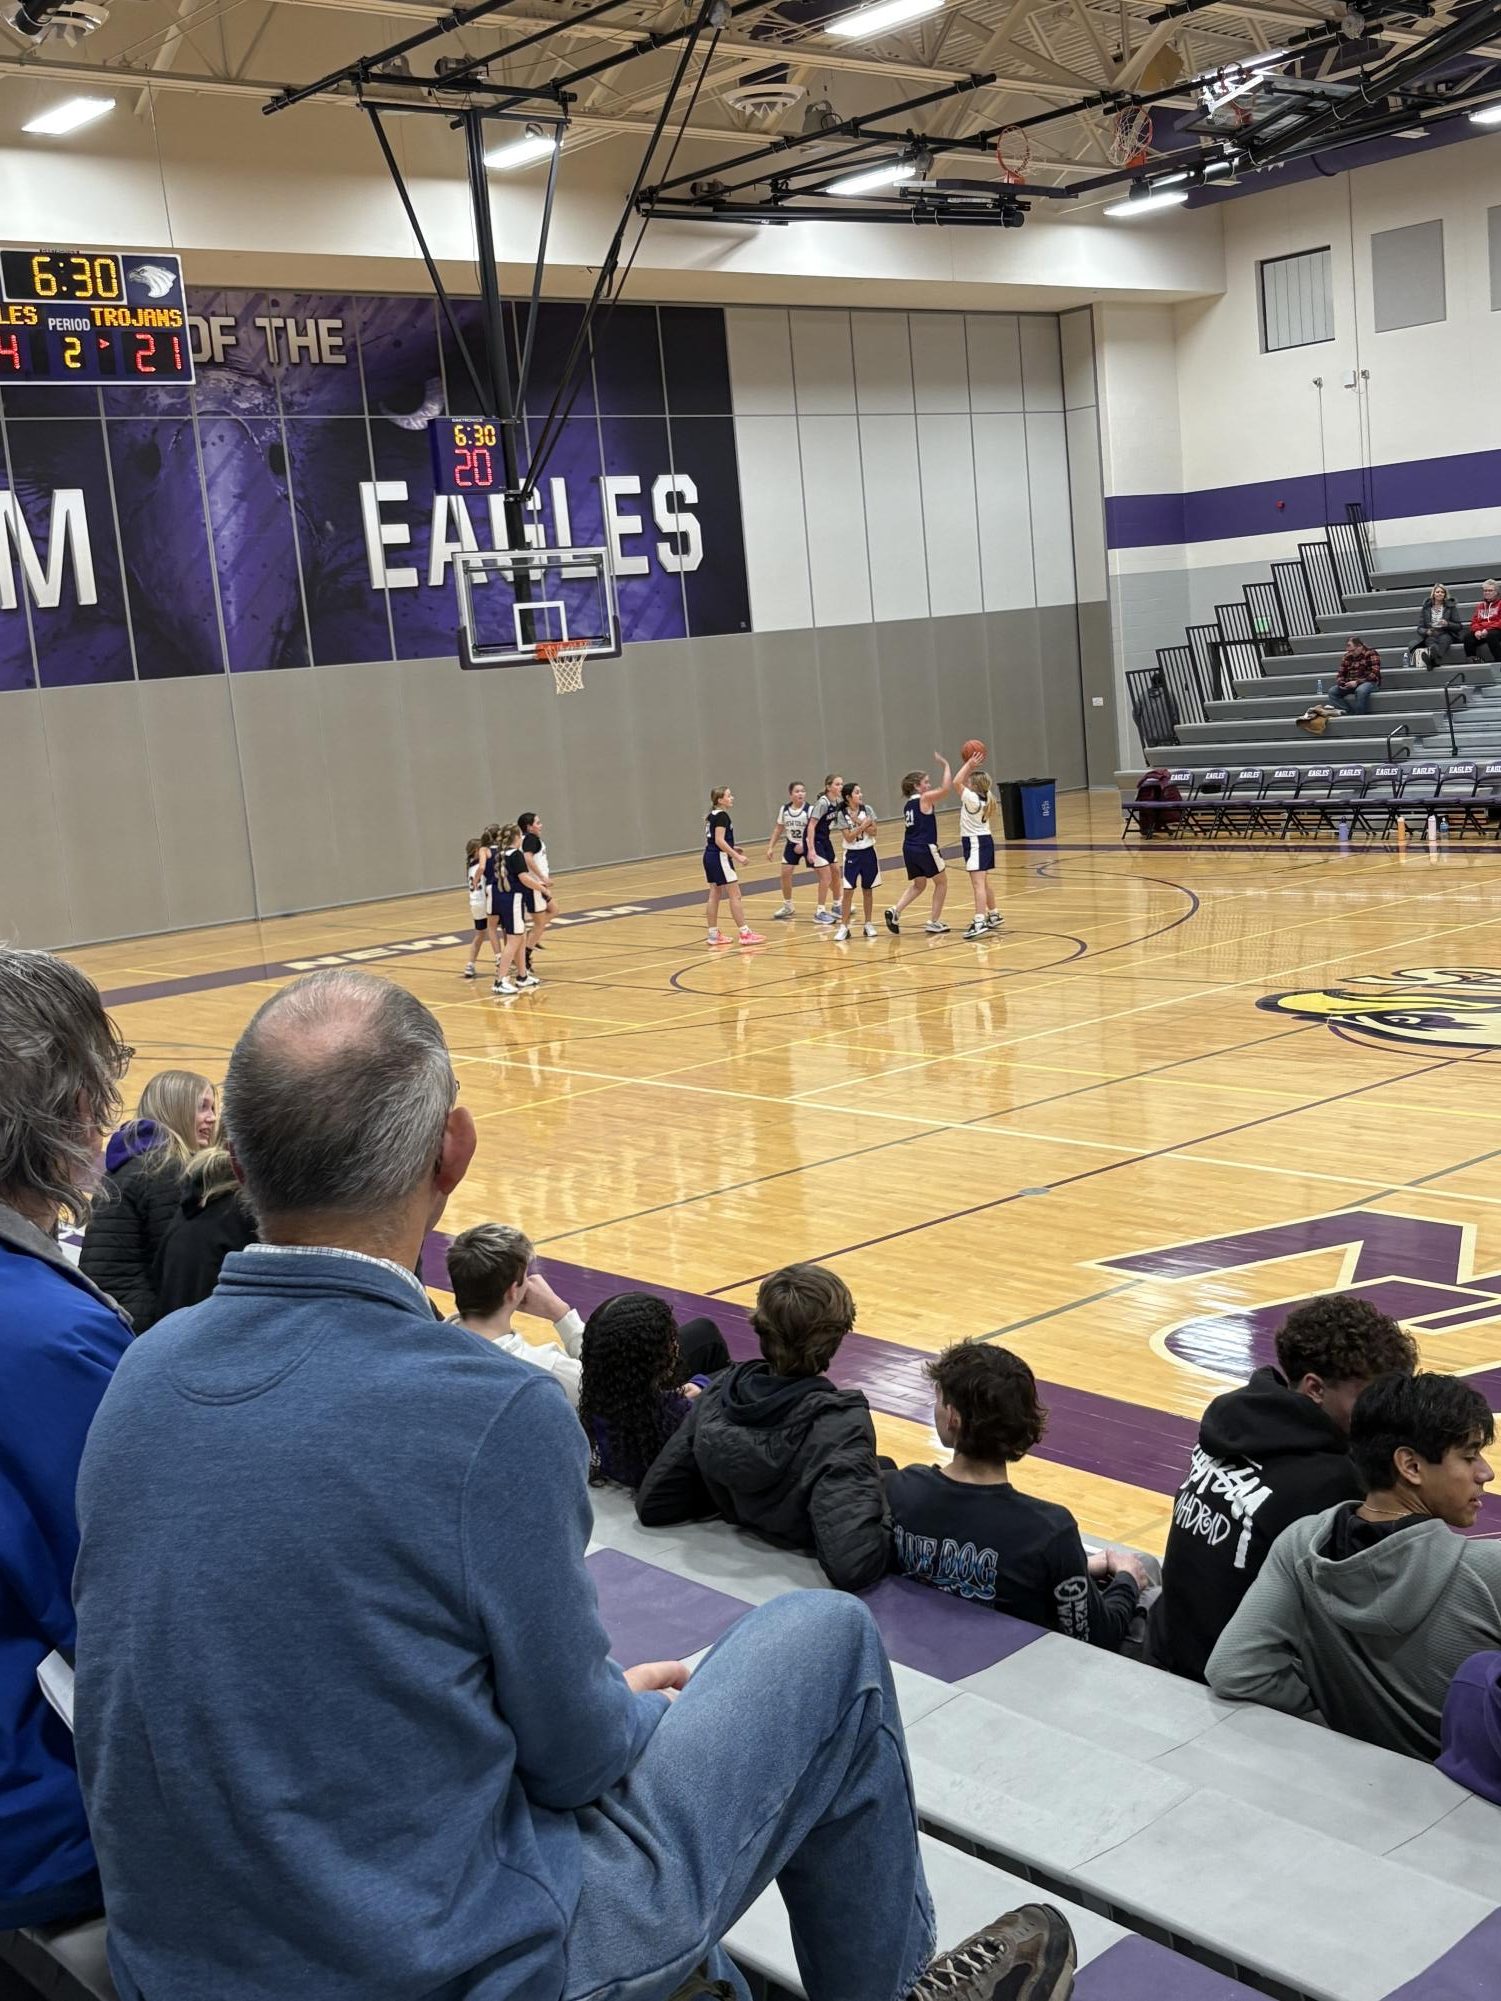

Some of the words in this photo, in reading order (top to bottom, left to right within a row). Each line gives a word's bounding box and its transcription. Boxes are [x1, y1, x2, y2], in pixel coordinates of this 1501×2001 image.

[31, 256, 117, 298] 6:30
[48, 317, 91, 331] PERIOD
[90, 307, 184, 328] TROJANS
[190, 315, 239, 363] OF
[255, 315, 347, 365] THE
[64, 337, 82, 368] 2
[135, 332, 182, 372] 21
[454, 424, 497, 446] 6:30
[454, 449, 493, 487] 20
[358, 474, 705, 590] EAGLES
[1170, 773, 1190, 781] EAGLES
[1205, 772, 1226, 780] EAGLES
[1239, 771, 1260, 779] EAGLES
[1274, 770, 1296, 778] EAGLES
[1307, 769, 1330, 777] EAGLES
[1338, 768, 1362, 776] EAGLES
[1412, 767, 1437, 775] EAGLES
[1448, 765, 1474, 773] EAGLES
[790, 829, 802, 839] 22
[282, 936, 464, 970] NEW
[938, 1538, 999, 1588] DOG
